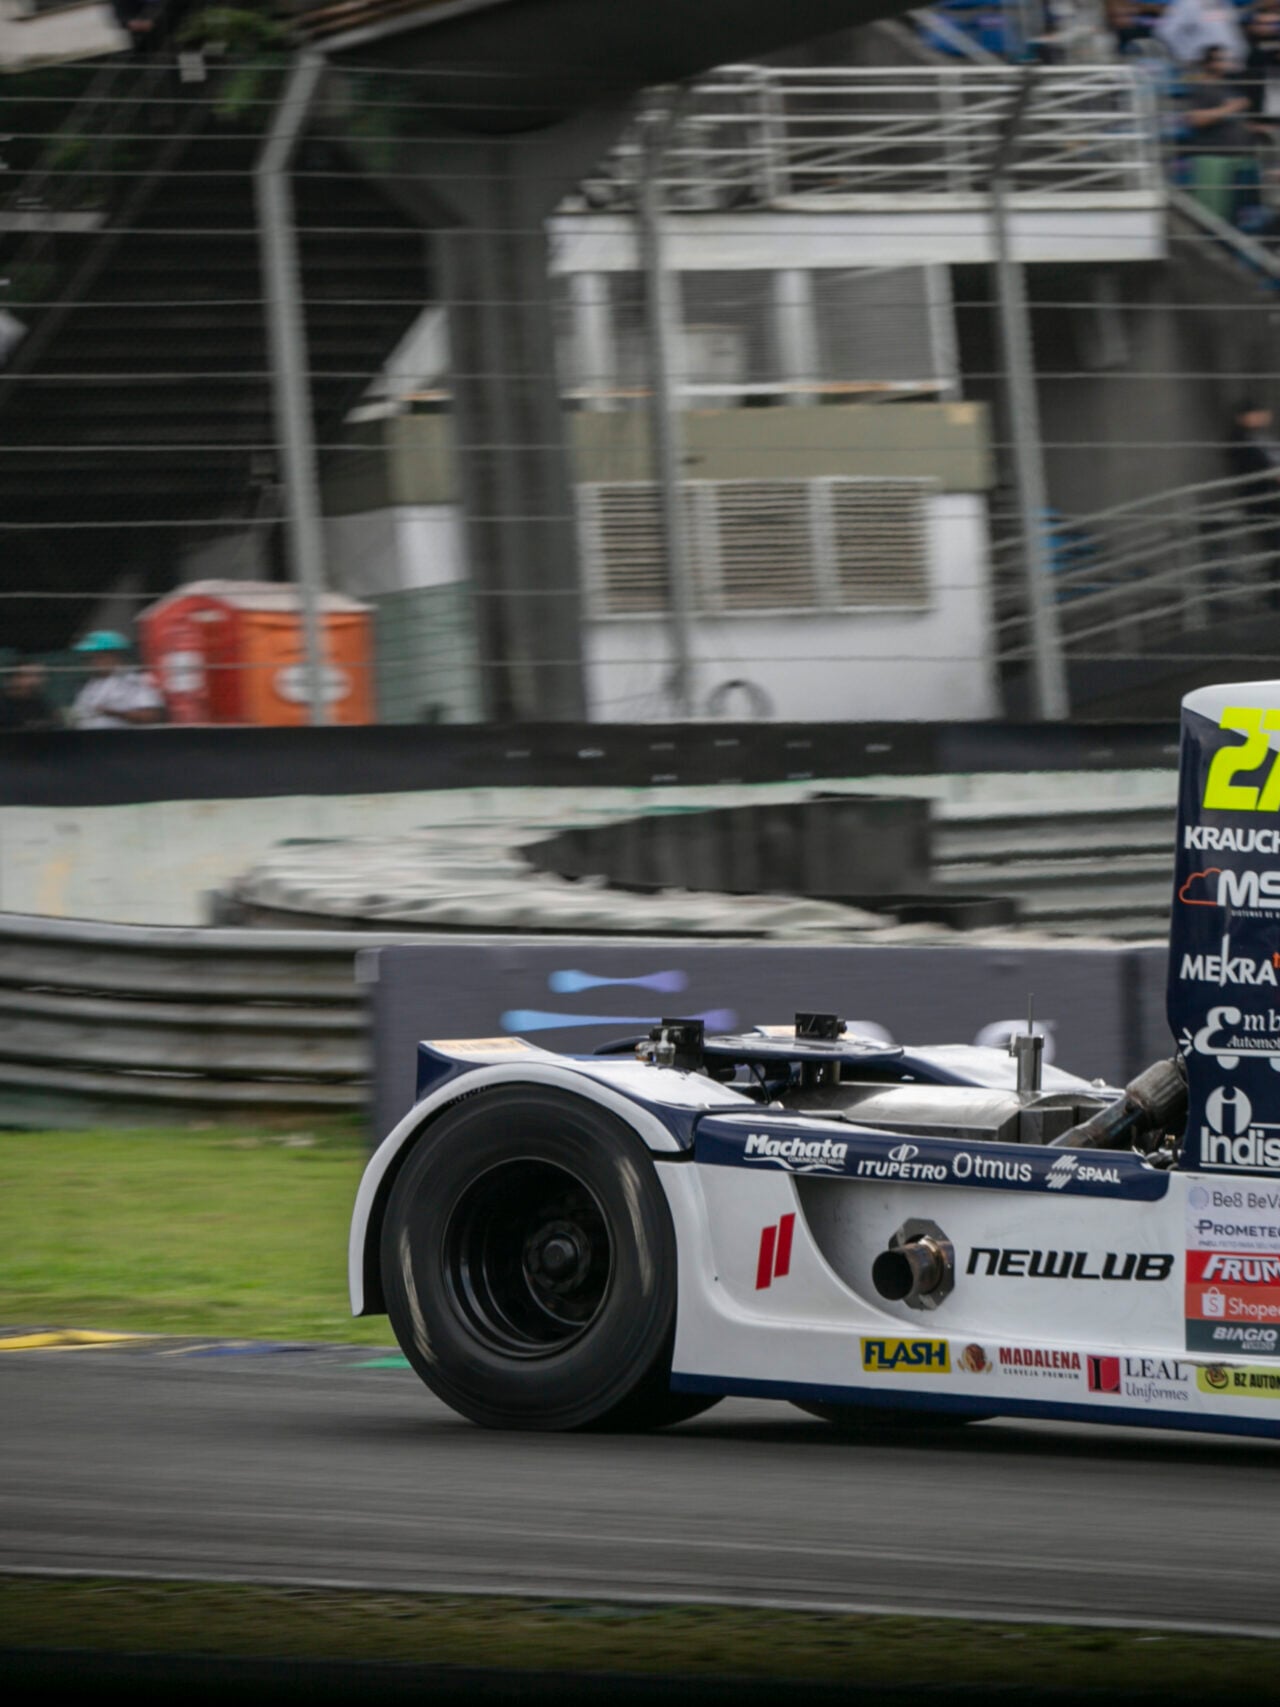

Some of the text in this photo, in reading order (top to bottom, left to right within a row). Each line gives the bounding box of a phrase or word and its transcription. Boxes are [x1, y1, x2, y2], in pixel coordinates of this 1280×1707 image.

[1179, 933, 1279, 988] MEKRA
[744, 1134, 849, 1159] Machata
[857, 1160, 948, 1180] ITUPETRO
[952, 1152, 1033, 1182] Otmus
[1077, 1166, 1121, 1184] SPAAL
[1212, 1191, 1244, 1208] Be8
[966, 1247, 1175, 1281] NEWLUB
[1213, 1326, 1278, 1342] BIAGIO
[864, 1342, 947, 1370] FLASH
[999, 1347, 1082, 1371] MADALENA
[1124, 1358, 1189, 1382] LEAL
[1233, 1372, 1248, 1388] BZ
[1125, 1382, 1189, 1402] Uniformes
